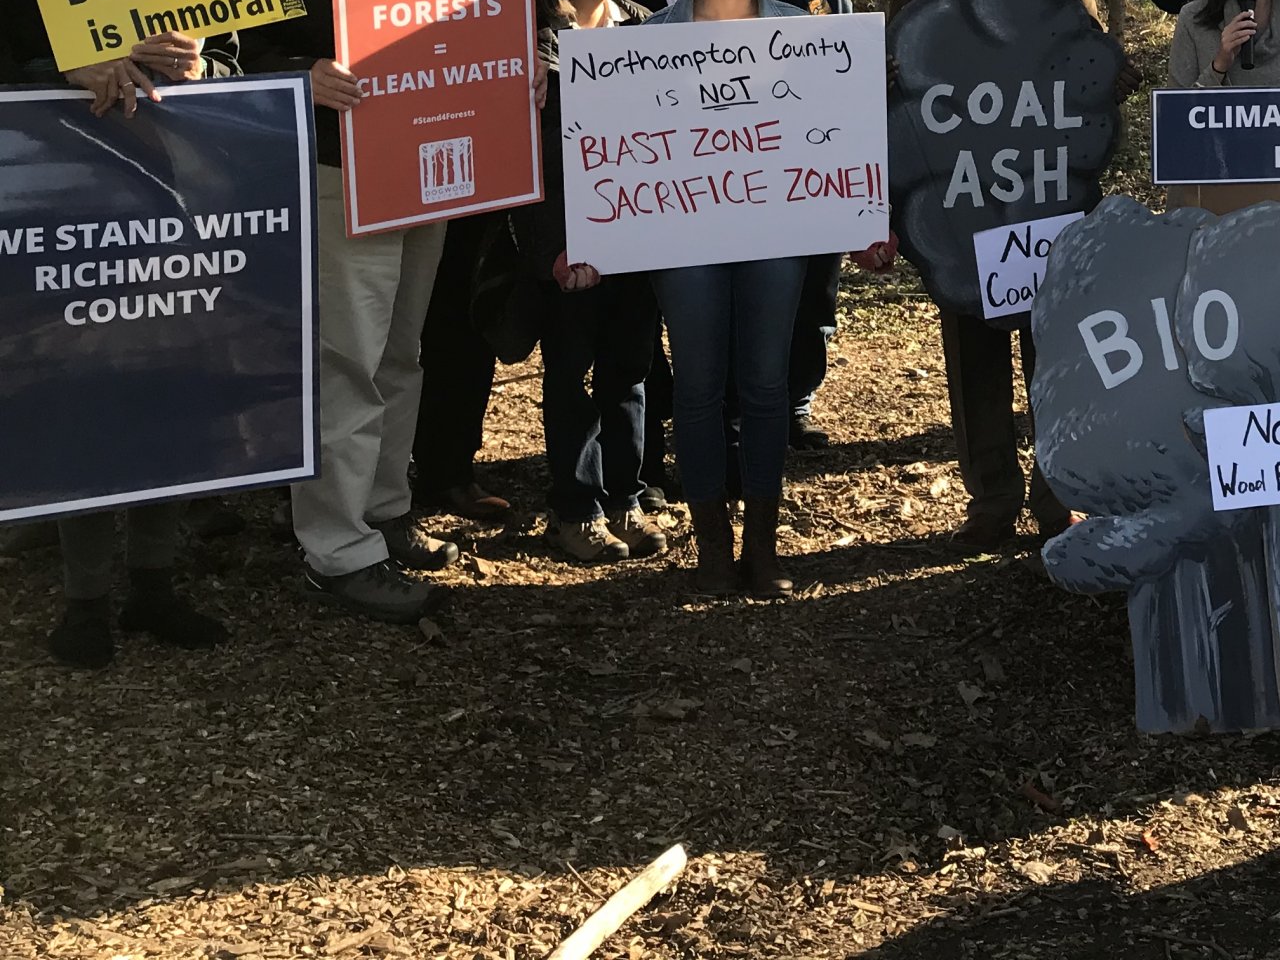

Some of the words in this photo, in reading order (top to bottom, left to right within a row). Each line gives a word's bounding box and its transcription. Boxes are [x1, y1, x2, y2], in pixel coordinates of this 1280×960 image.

[87, 19, 122, 52] is
[570, 42, 756, 84] Northampton
[768, 29, 852, 74] County
[356, 69, 435, 97] CLEAN
[442, 58, 525, 86] WATER
[656, 89, 679, 107] is
[700, 76, 752, 105] NOT
[771, 79, 802, 101] a
[413, 110, 475, 125] #Stand4Forests
[920, 80, 1083, 134] COAL
[690, 120, 782, 158] ZONE
[806, 128, 841, 145] or
[586, 170, 767, 223] SACRIFICE
[784, 163, 884, 206] ZONE!!
[943, 146, 1069, 208] ASH
[55, 217, 184, 252] STAND
[195, 207, 289, 240] WITH
[1000, 225, 1051, 262] No
[35, 248, 247, 291] RICHMOND
[64, 286, 222, 326] COUNTY
[986, 272, 1037, 308] Coal
[1078, 289, 1239, 389] BIO
[1217, 462, 1266, 498] Wood
